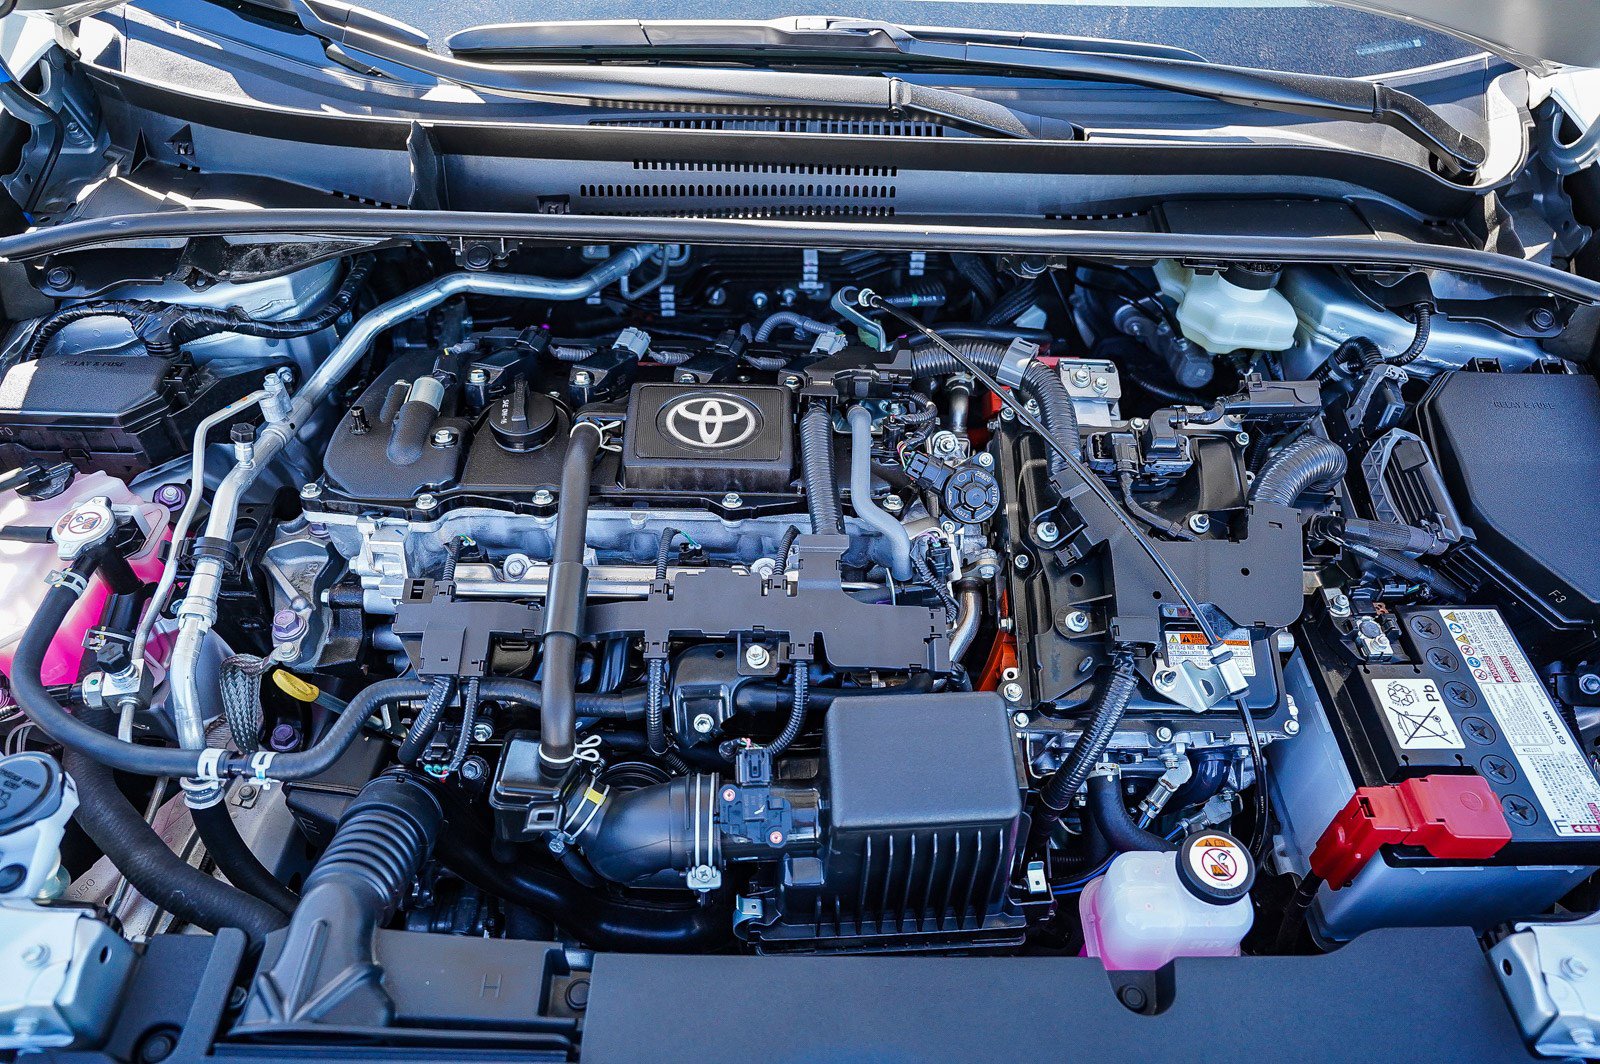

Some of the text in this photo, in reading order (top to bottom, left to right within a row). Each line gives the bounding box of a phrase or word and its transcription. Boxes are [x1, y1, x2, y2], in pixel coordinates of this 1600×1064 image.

[1548, 589, 1567, 603] F3
[1423, 685, 1440, 702] Pb
[1542, 710, 1566, 744] GS YUASA
